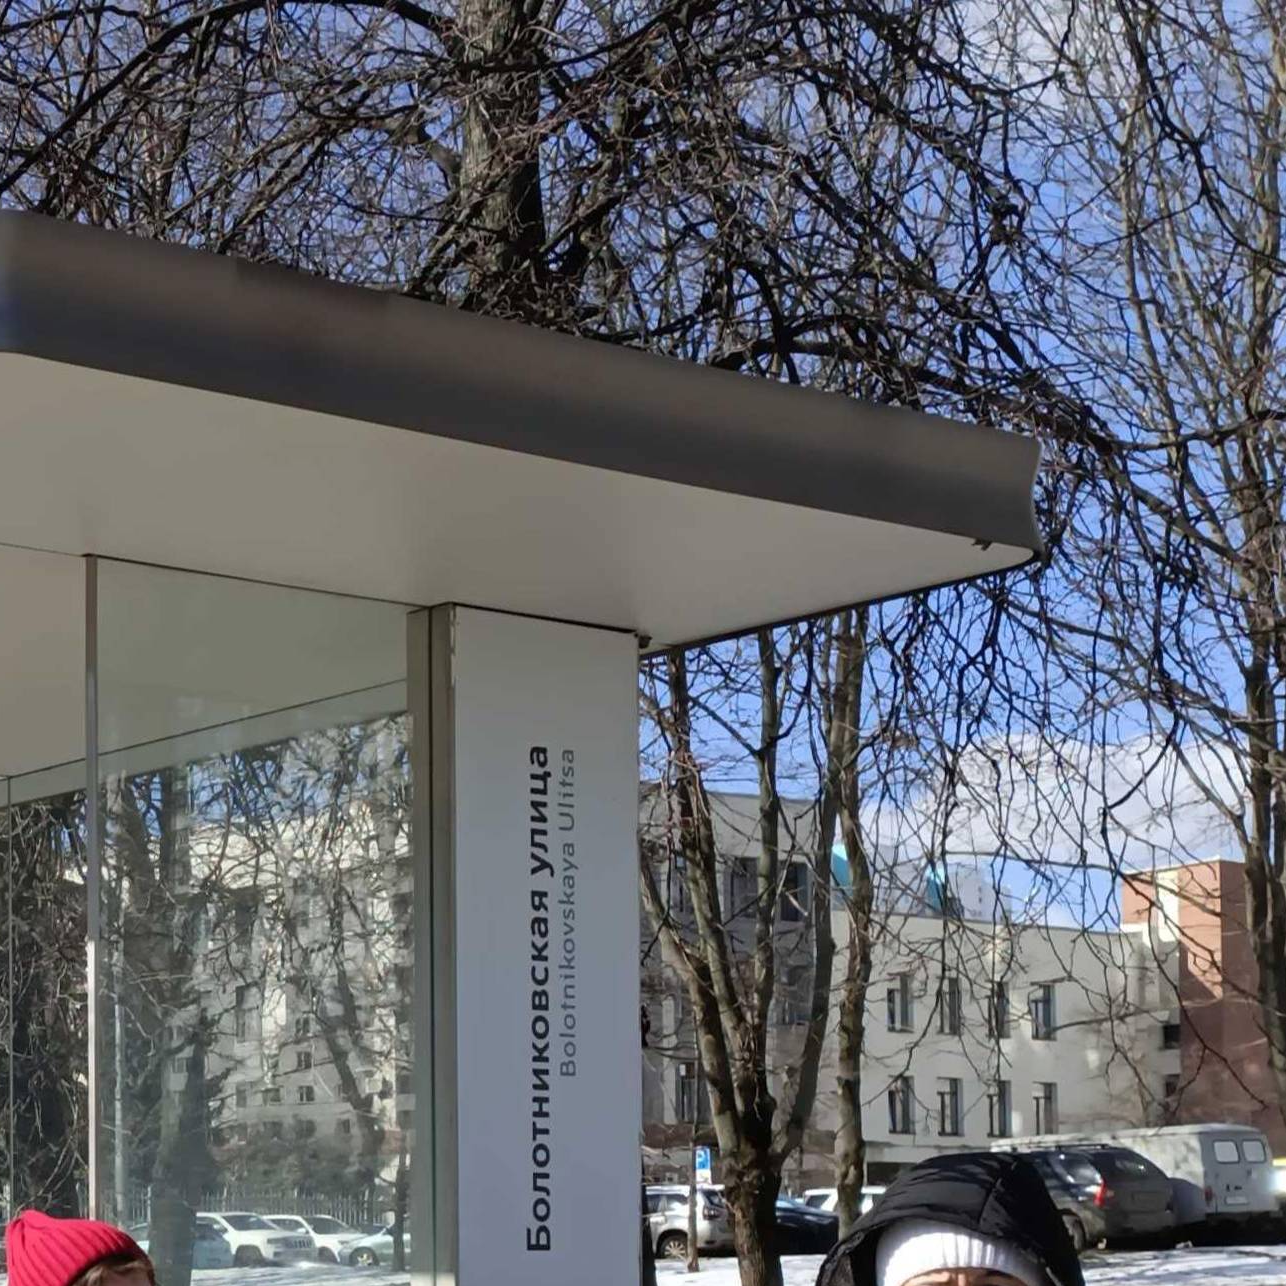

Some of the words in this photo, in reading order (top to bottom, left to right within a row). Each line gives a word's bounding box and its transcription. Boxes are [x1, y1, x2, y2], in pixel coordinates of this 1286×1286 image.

[530, 745, 555, 878] улица
[557, 749, 575, 832] Ulitsa
[559, 842, 579, 1077] Bolotnikovskaya
[527, 889, 552, 1251] Болотниковская
